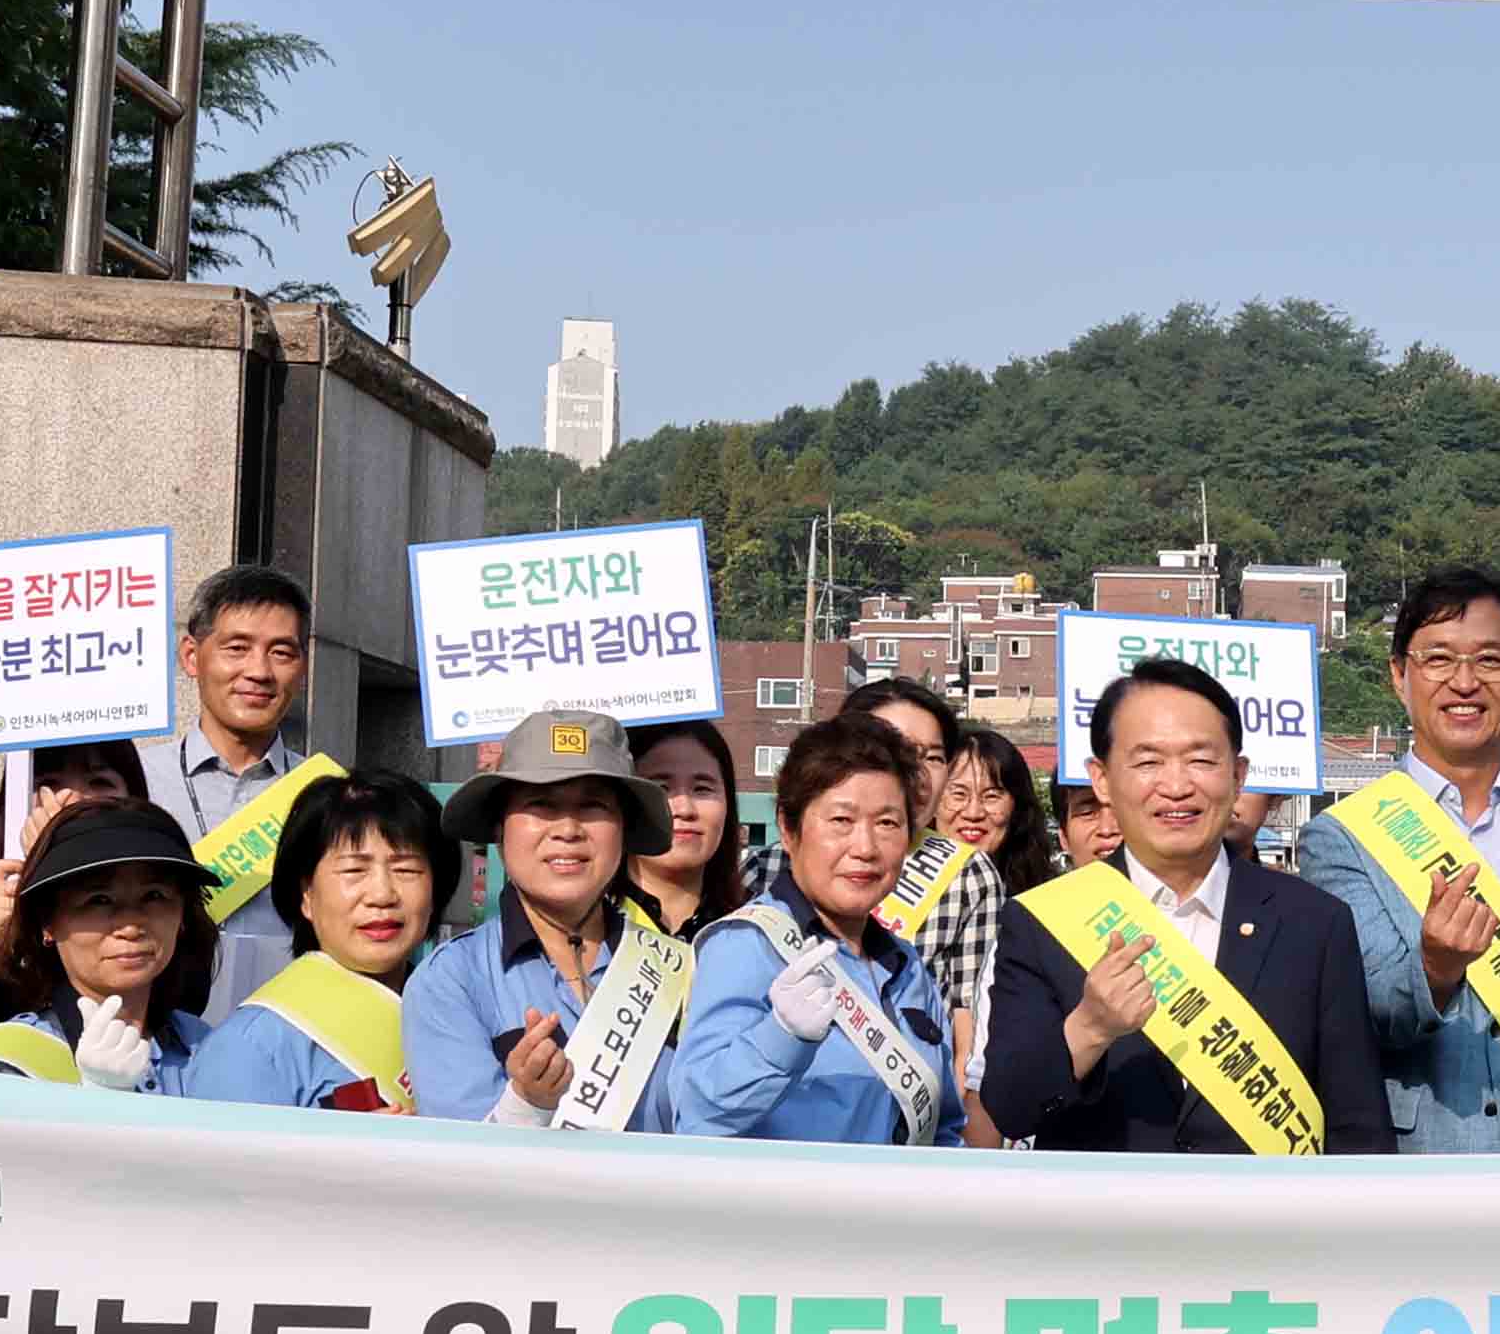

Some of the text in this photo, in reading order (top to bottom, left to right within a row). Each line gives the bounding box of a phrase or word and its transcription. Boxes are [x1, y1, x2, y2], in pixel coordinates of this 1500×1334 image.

[479, 549, 644, 610] 운전자와
[435, 609, 701, 680] 눈맞추며 걸어요
[9, 703, 149, 732] 인천시녹색어머니연합회
[1230, 694, 1307, 738] 어요
[573, 957, 663, 1116] 녹색어머니회
